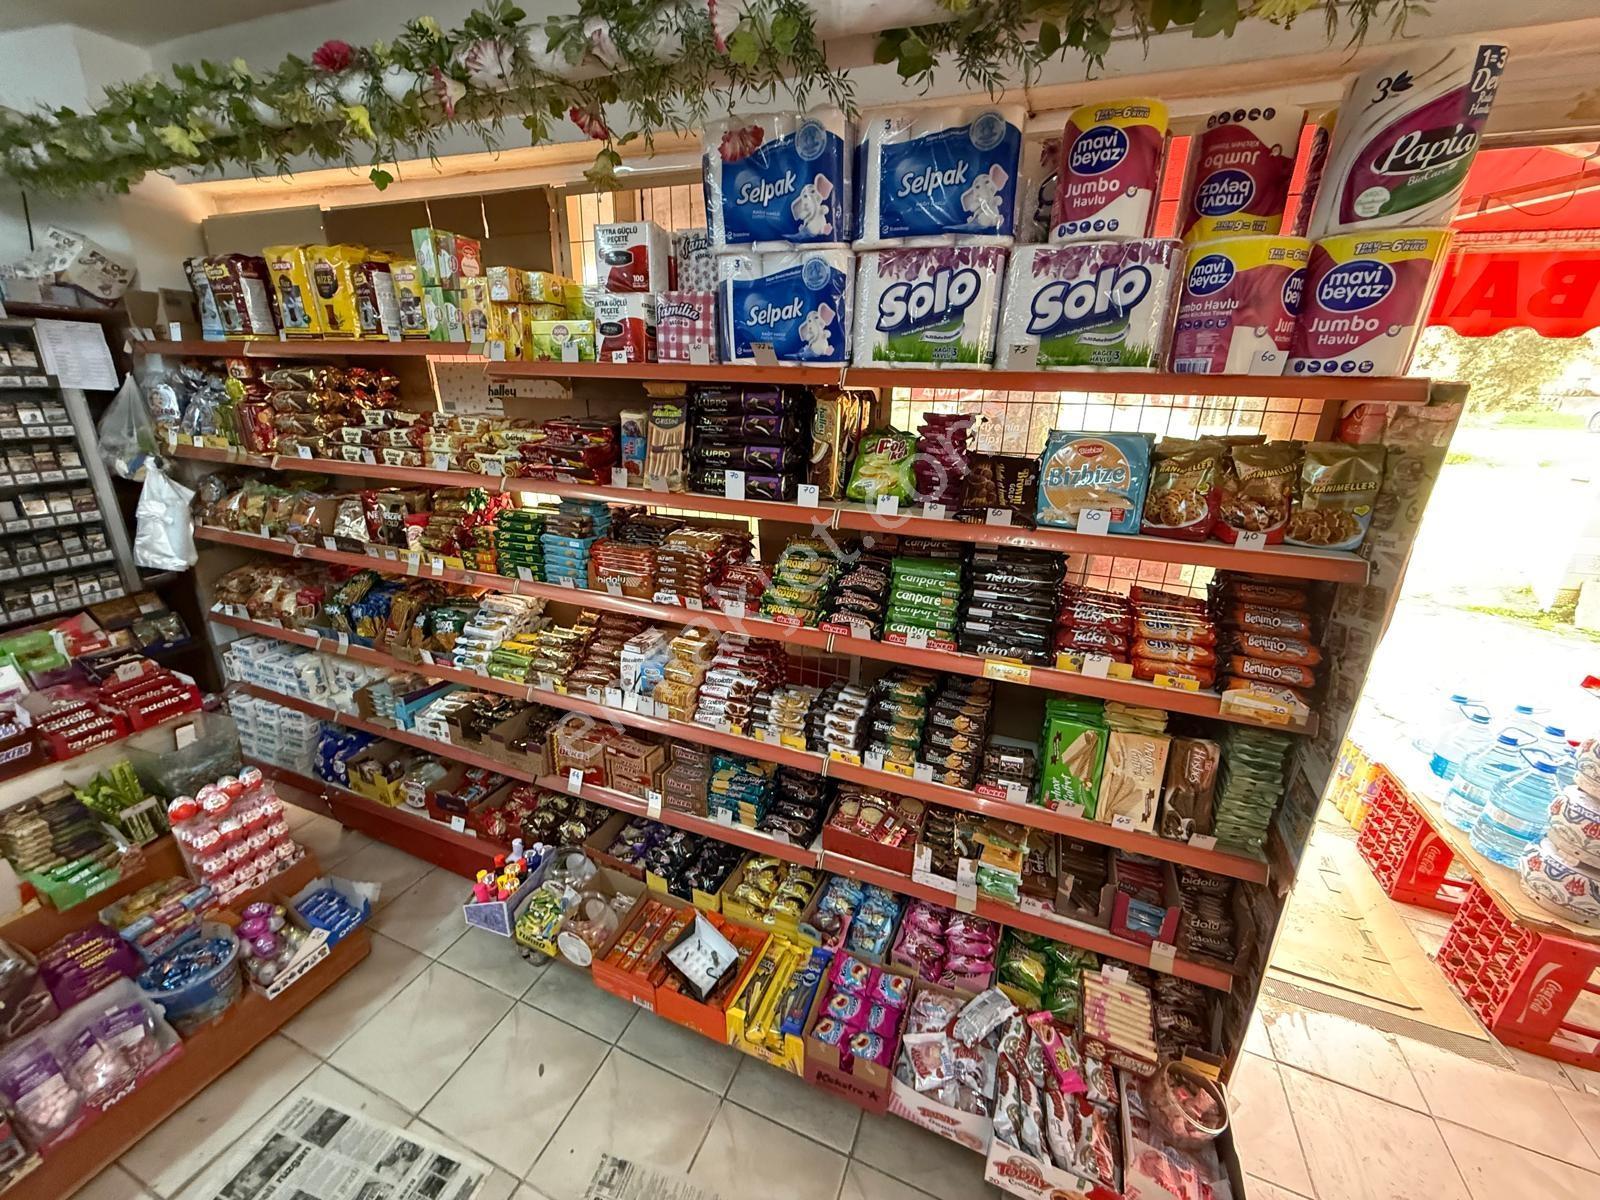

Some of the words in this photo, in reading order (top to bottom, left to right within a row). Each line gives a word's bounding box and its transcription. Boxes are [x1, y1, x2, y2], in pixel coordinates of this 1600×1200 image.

[1077, 131, 1118, 153] mavi
[1379, 123, 1477, 174] Papia
[1072, 147, 1121, 167] beyaz
[1204, 150, 1261, 168] Jumbo
[898, 159, 969, 197] Selpak
[736, 170, 796, 207] Selpak
[1065, 177, 1120, 198] Jumbo
[1200, 178, 1251, 196] beyaz
[1073, 195, 1105, 208] Havlu
[1200, 194, 1244, 212] mavi
[1391, 240, 1402, 252] 6
[1194, 258, 1226, 276] mavi
[1189, 272, 1228, 289] beyaz
[1329, 265, 1384, 286] mavi
[877, 267, 981, 332] Solo
[1027, 264, 1152, 334] Solo
[1320, 284, 1383, 304] beyaz
[1204, 297, 1239, 310] Havlu
[657, 301, 700, 325] Familia
[746, 296, 804, 329] Selpak
[1309, 315, 1379, 332] Jumbo
[1317, 334, 1359, 345] Havlu
[1013, 344, 1028, 354] 75
[1261, 350, 1276, 362] 60
[488, 384, 517, 398] halley
[699, 399, 729, 408] LUPPO
[818, 408, 829, 436] halley
[701, 450, 731, 459] LUPPO
[729, 472, 739, 480] 70
[1048, 464, 1126, 488] Bizbize
[803, 486, 816, 494] 70
[1312, 481, 1377, 494] HANIMELLER
[1086, 511, 1101, 521] 60
[1243, 532, 1258, 541] 40
[900, 573, 946, 588] canpare
[984, 572, 1018, 584] nero
[895, 590, 942, 606] canpare
[981, 601, 1014, 611] nero
[890, 621, 937, 637] canpare
[1071, 629, 1107, 645] Tutku
[976, 643, 1009, 657] nero
[1088, 654, 1103, 663] 25
[1116, 816, 1131, 825] 45
[1181, 876, 1220, 888] bidolu
[517, 930, 546, 949] TURBO
